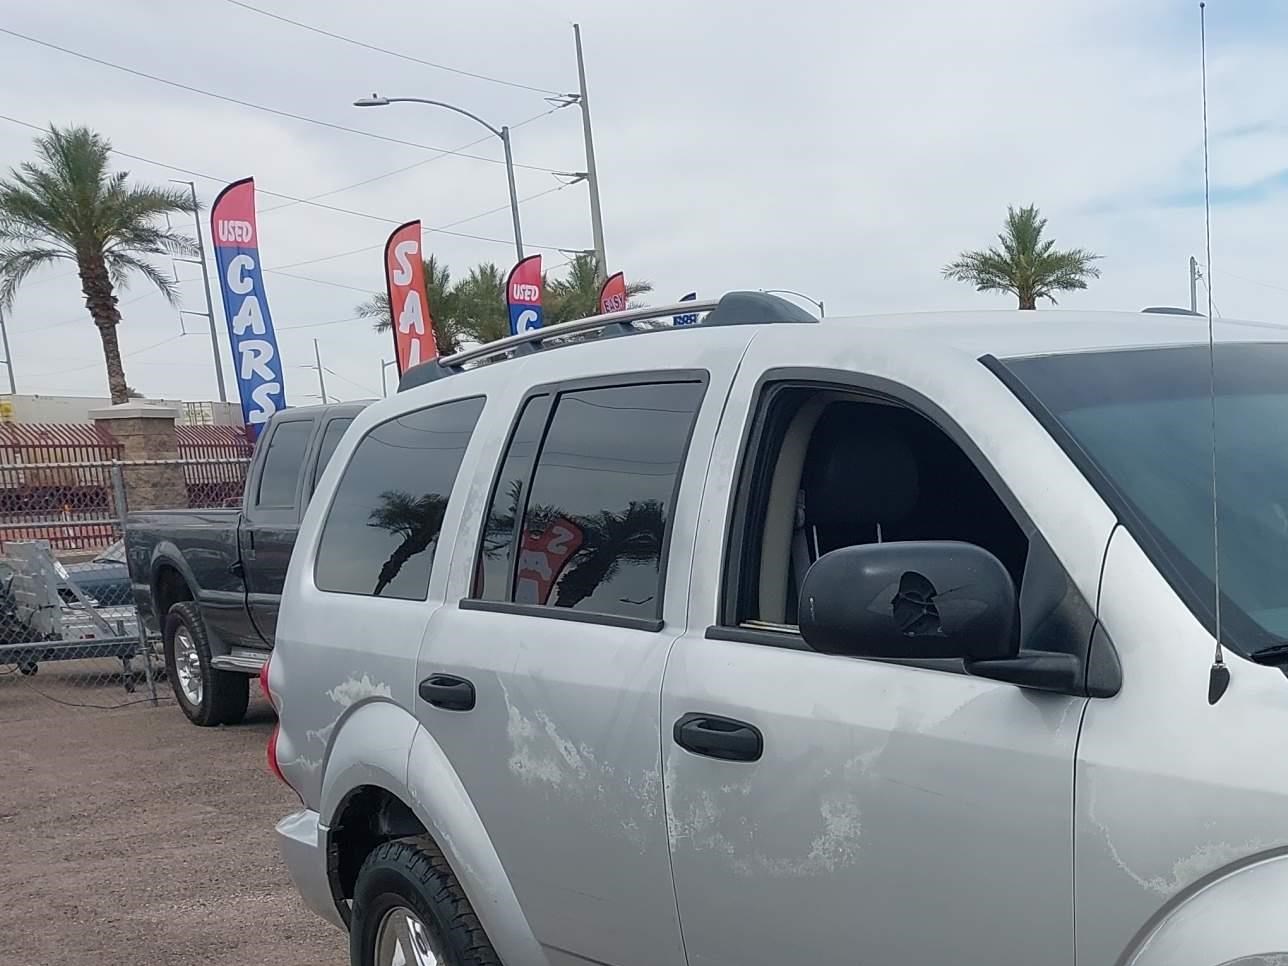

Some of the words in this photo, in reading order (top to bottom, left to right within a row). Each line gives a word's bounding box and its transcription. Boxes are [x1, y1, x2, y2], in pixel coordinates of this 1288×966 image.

[218, 219, 253, 243] USED
[513, 283, 540, 302] USED
[226, 254, 282, 424] CARS
